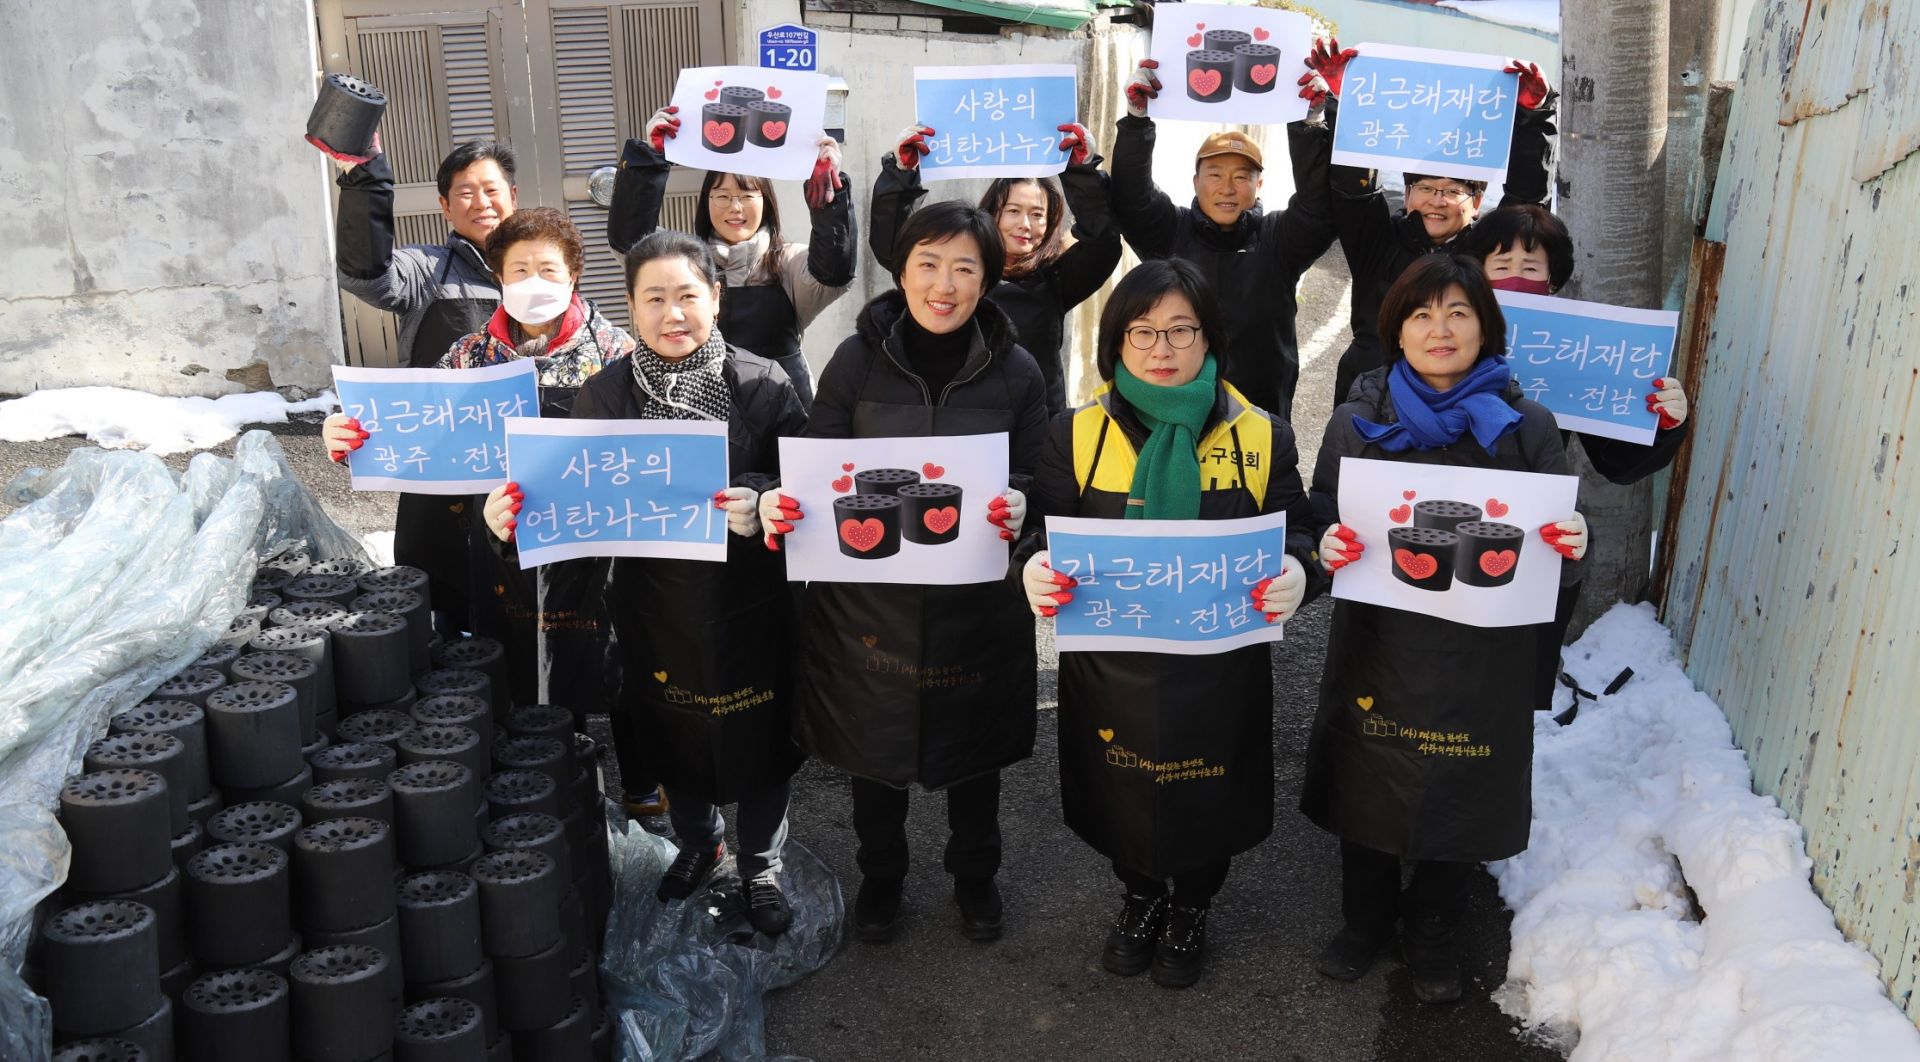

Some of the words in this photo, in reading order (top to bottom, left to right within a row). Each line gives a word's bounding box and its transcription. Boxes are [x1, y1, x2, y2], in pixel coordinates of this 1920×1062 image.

[766, 48, 812, 67] 1-20
[954, 87, 1035, 122] 사랑의
[1351, 72, 1507, 121] 김근태재단
[928, 131, 1065, 165] 연탄나누기
[1357, 119, 1410, 150] 광주
[374, 445, 431, 474] 광주
[561, 447, 671, 488] 사랑의
[526, 498, 712, 543] 연탄나누기
[1061, 549, 1271, 594] 김근태재단
[1084, 599, 1151, 630] 광주
